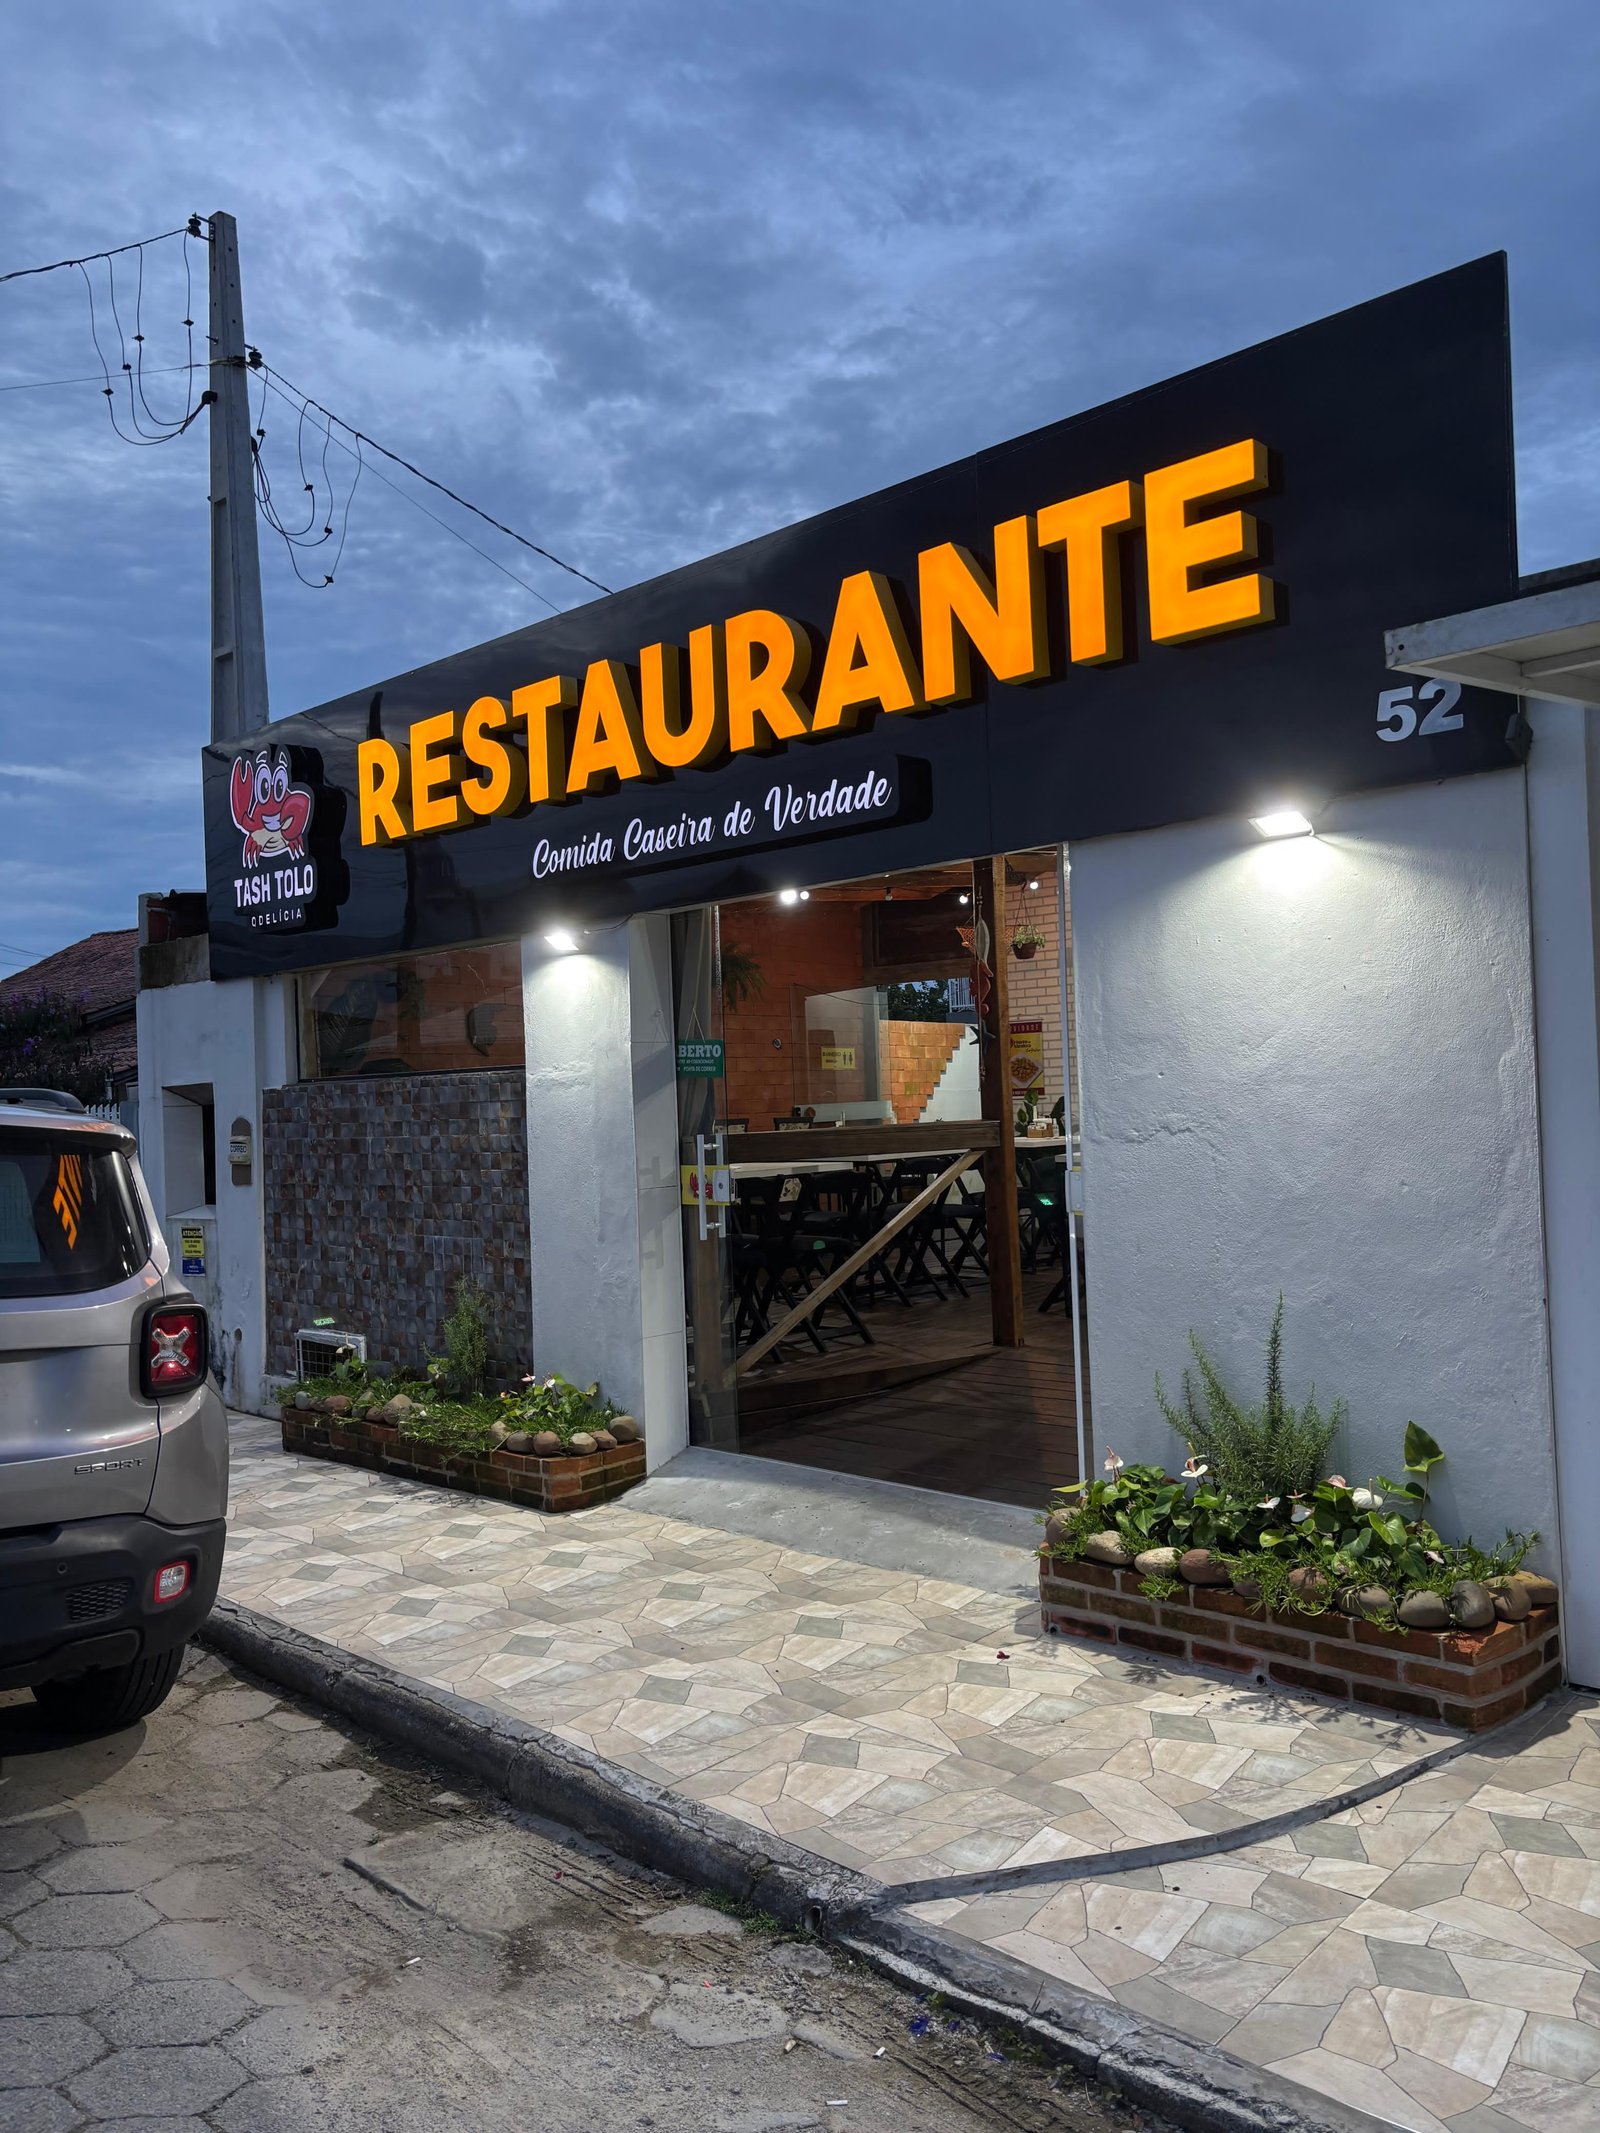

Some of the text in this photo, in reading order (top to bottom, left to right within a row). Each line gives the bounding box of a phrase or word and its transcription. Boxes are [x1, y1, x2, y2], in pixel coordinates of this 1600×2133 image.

[357, 438, 1273, 848] RESTAURANTE
[1376, 677, 1464, 742] 52
[532, 770, 893, 879] Comida Caseira de Verdade
[234, 864, 313, 907] TASH TOLO
[677, 1044, 721, 1058] BERTO
[74, 1457, 147, 1475] SPORT
